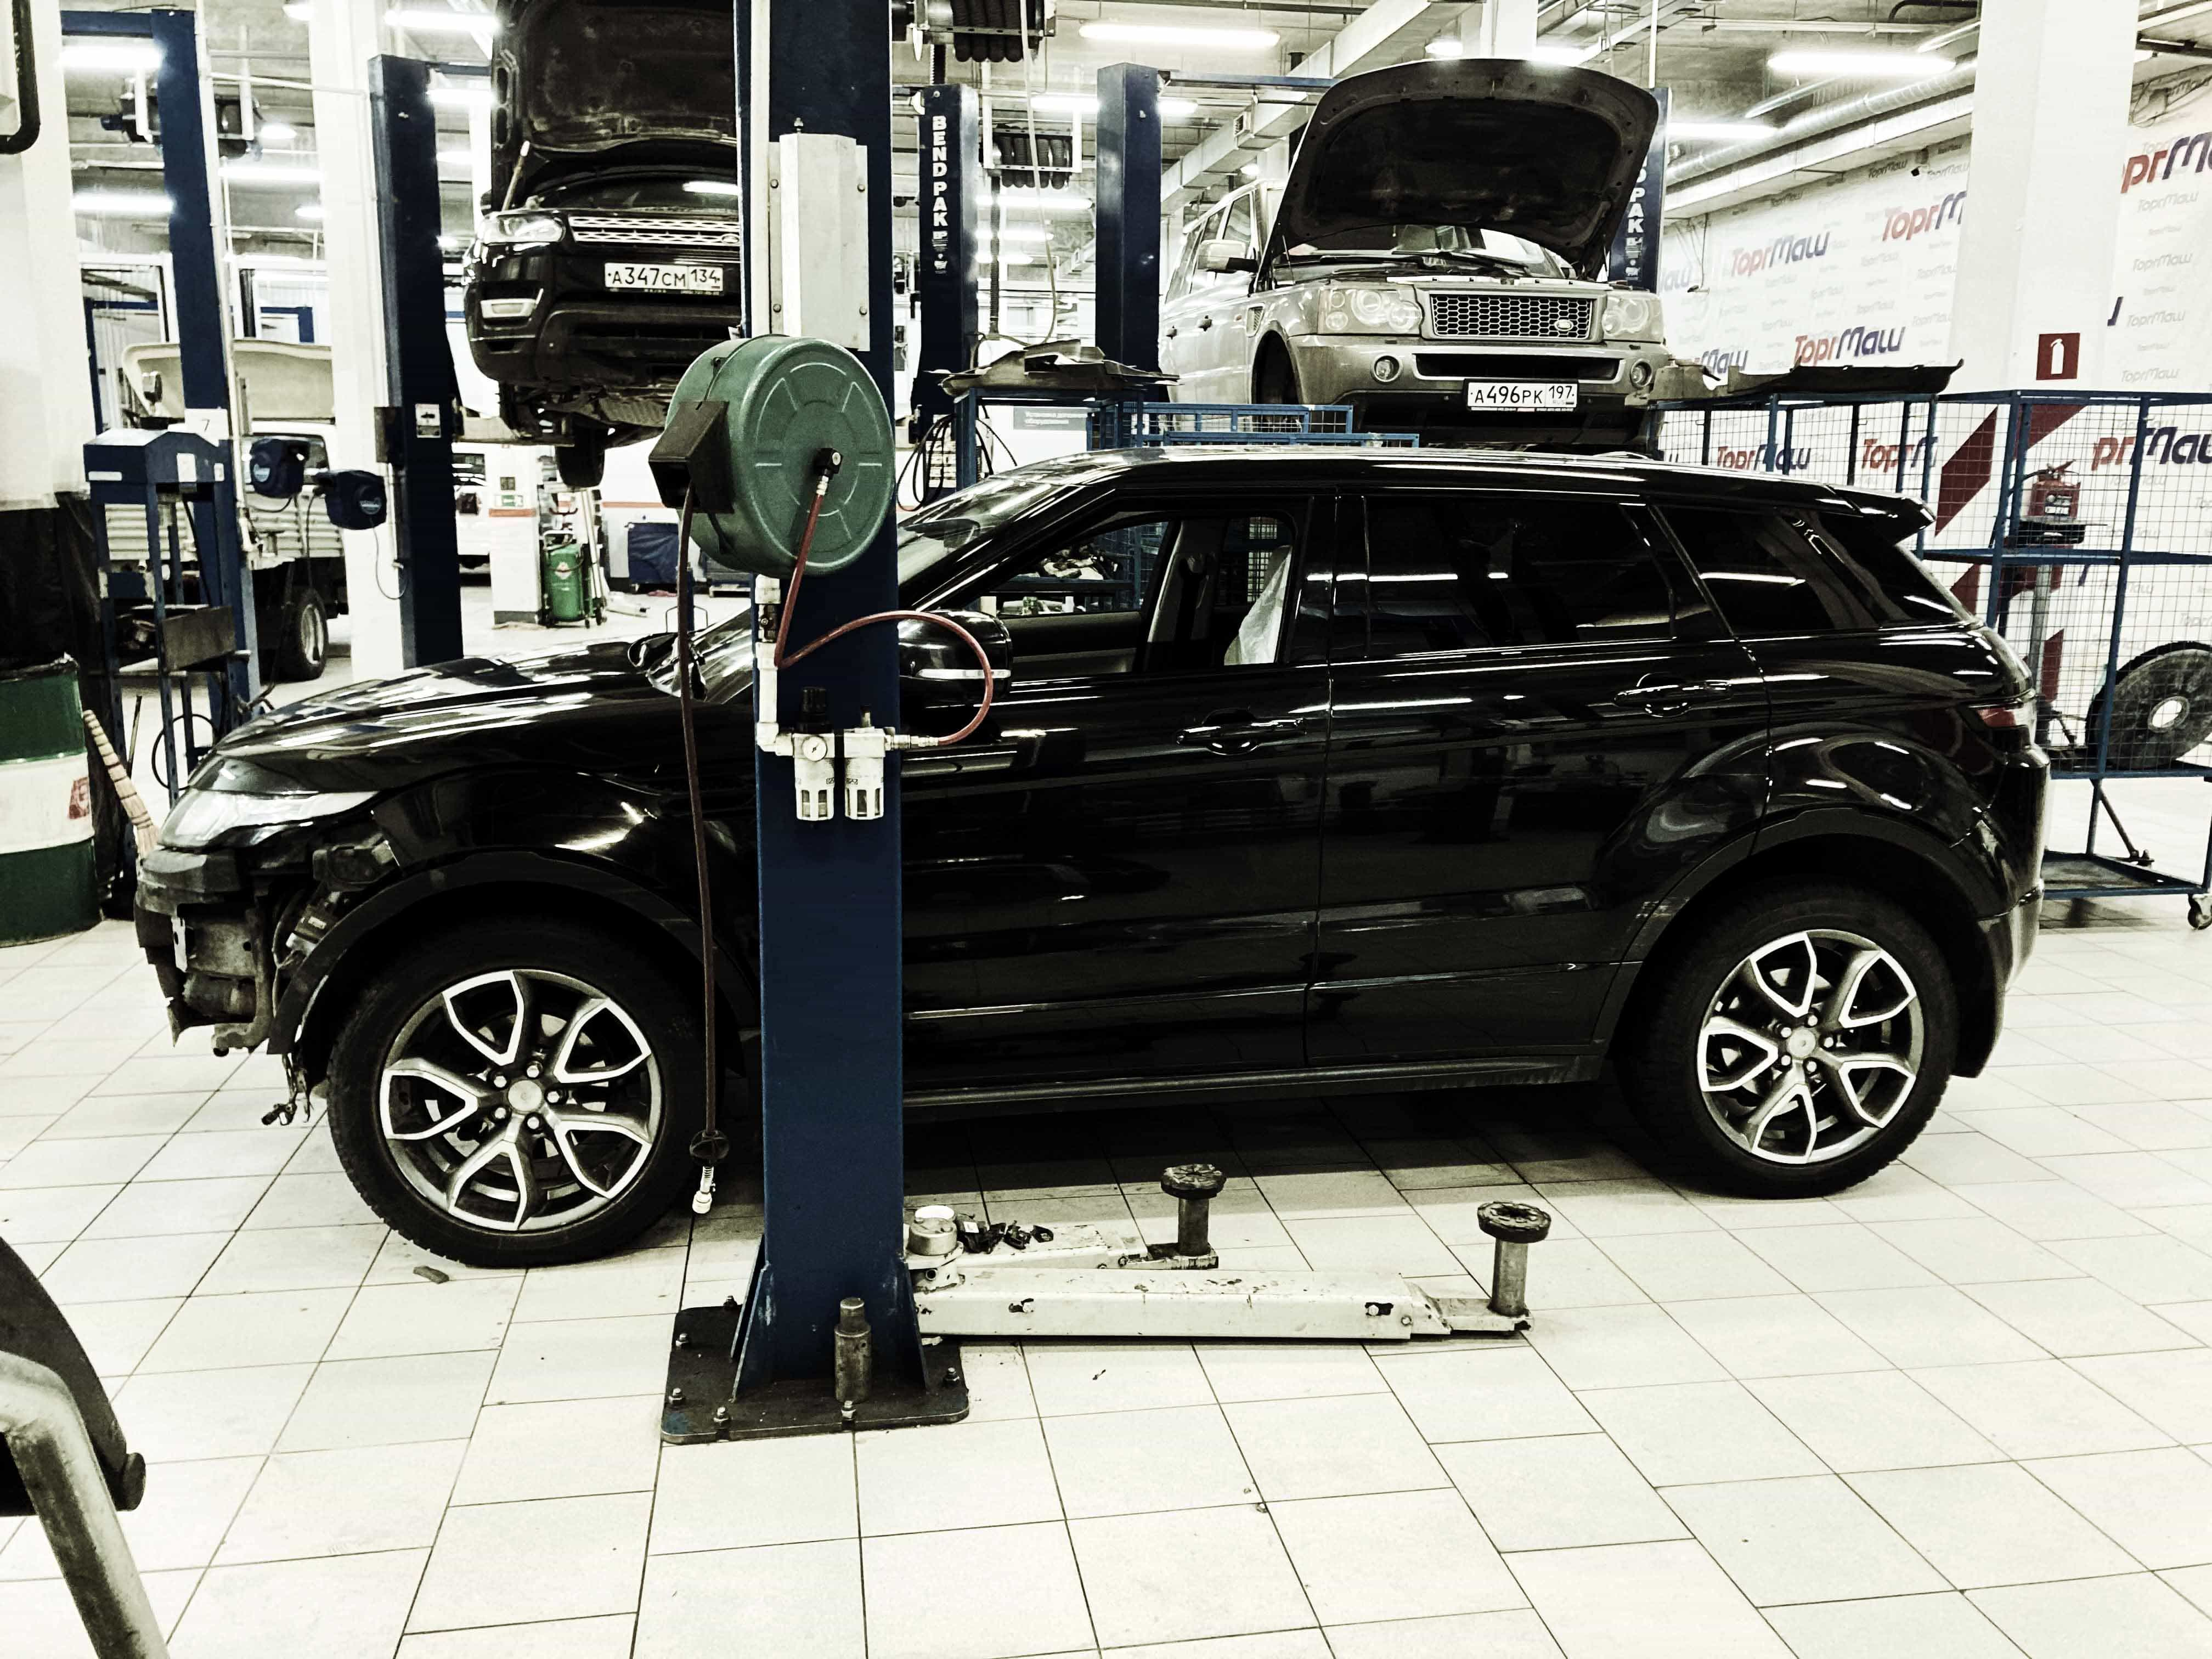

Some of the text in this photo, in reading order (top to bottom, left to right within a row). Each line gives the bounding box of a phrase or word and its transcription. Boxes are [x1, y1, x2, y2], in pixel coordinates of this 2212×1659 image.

[1882, 190, 1967, 241] ТоргМ
[691, 268, 718, 284] 134
[1475, 386, 1572, 404] А496РК 197
